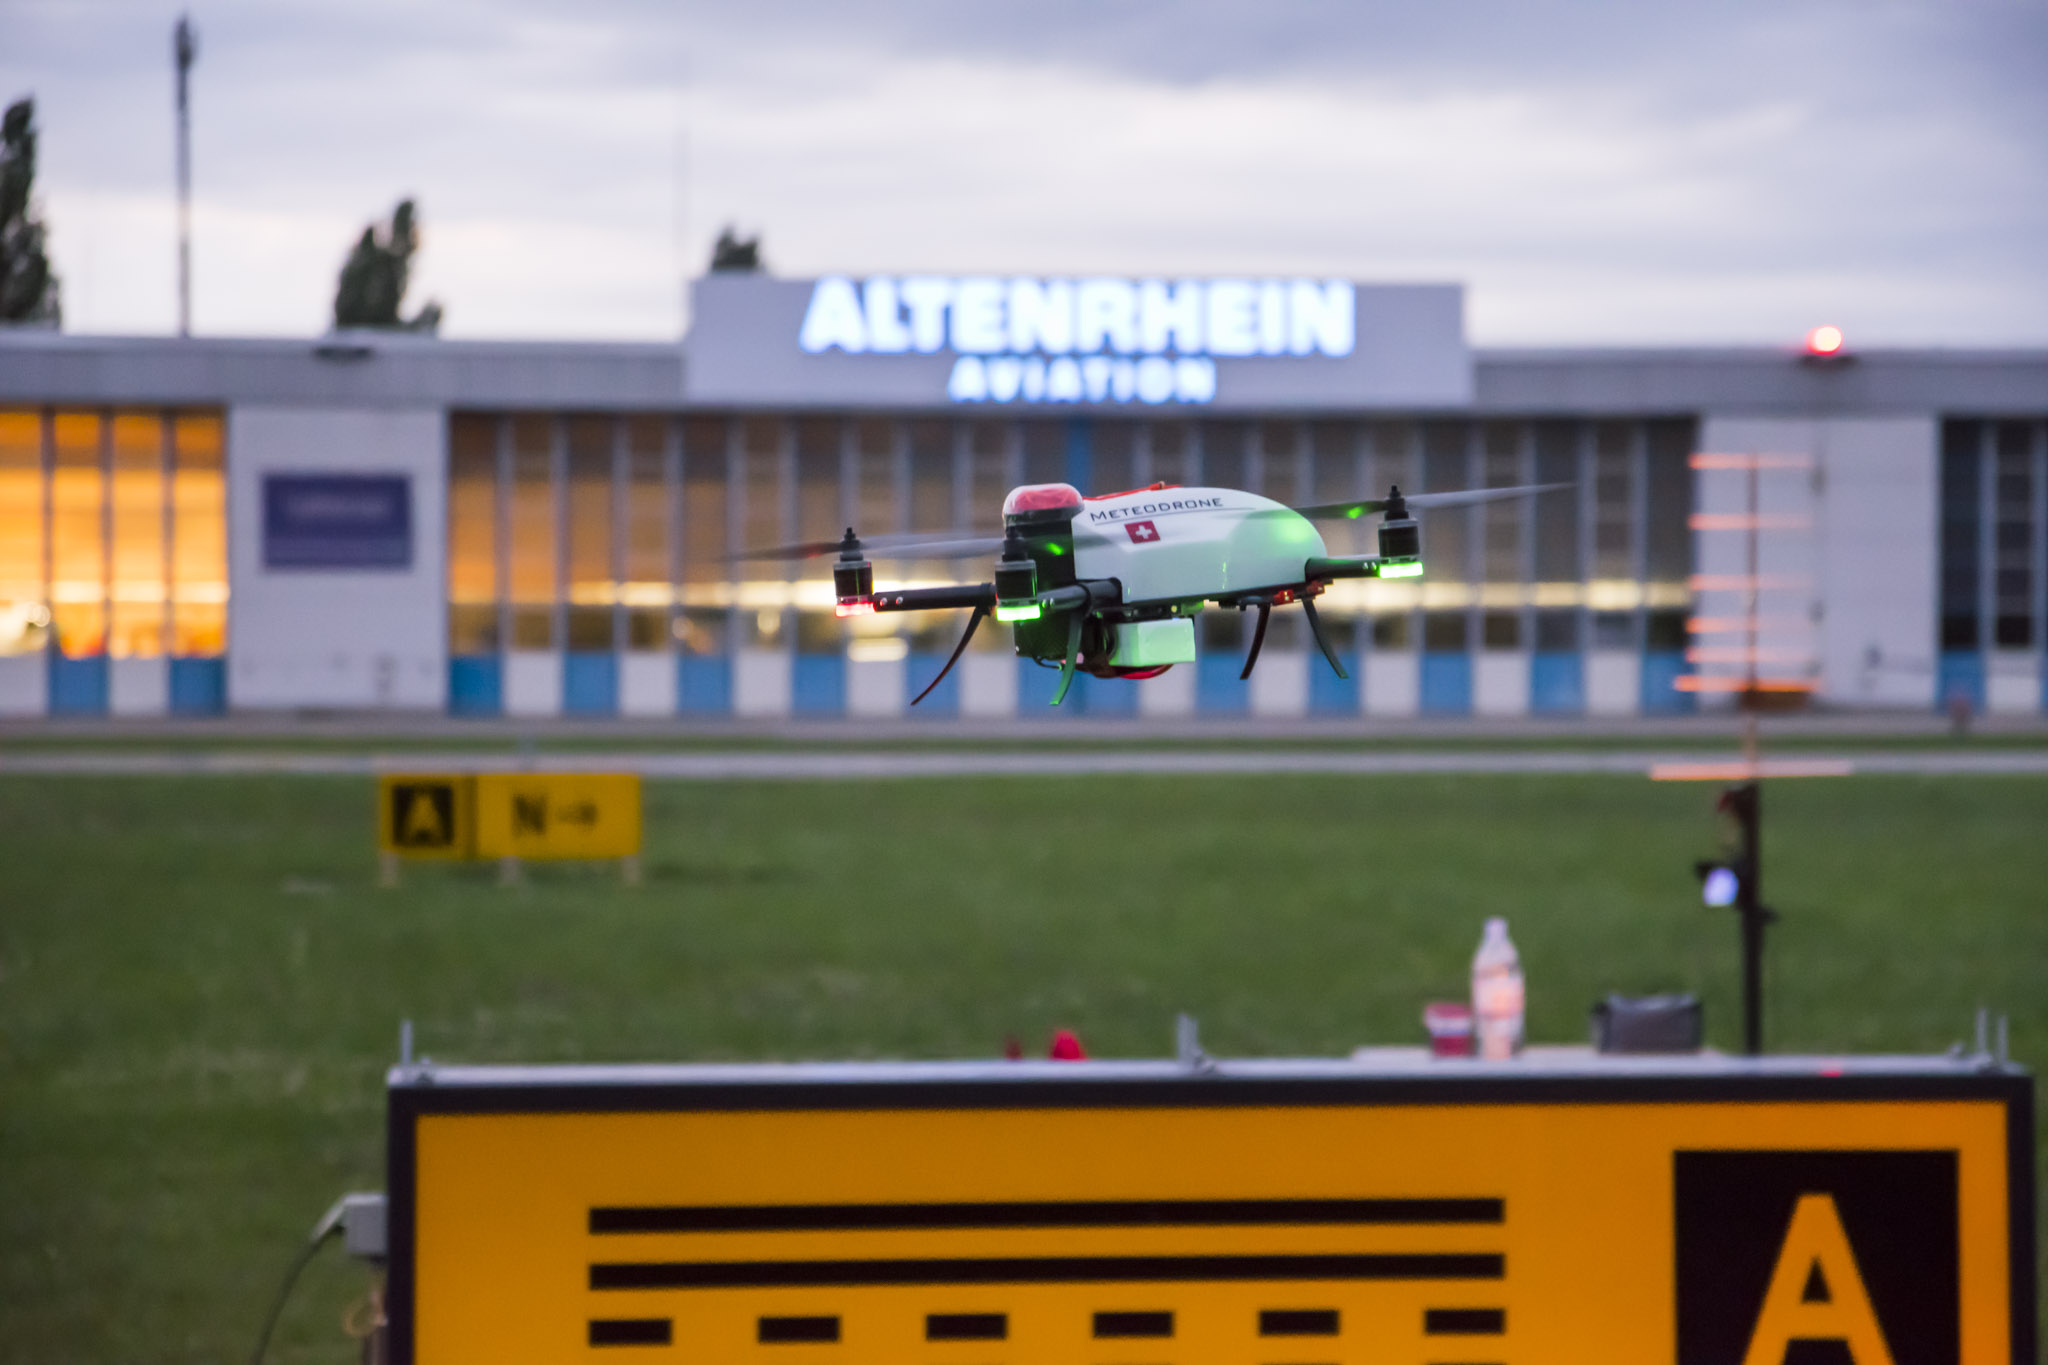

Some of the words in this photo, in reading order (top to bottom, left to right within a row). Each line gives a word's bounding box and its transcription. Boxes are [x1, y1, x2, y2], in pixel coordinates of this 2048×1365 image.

[800, 276, 1356, 356] ALTENRHEIN
[948, 355, 1216, 403] AVIATION
[1090, 498, 1224, 522] METEODRONE
[402, 790, 446, 845] A
[511, 794, 547, 836] N
[1741, 1194, 1897, 1365] A
